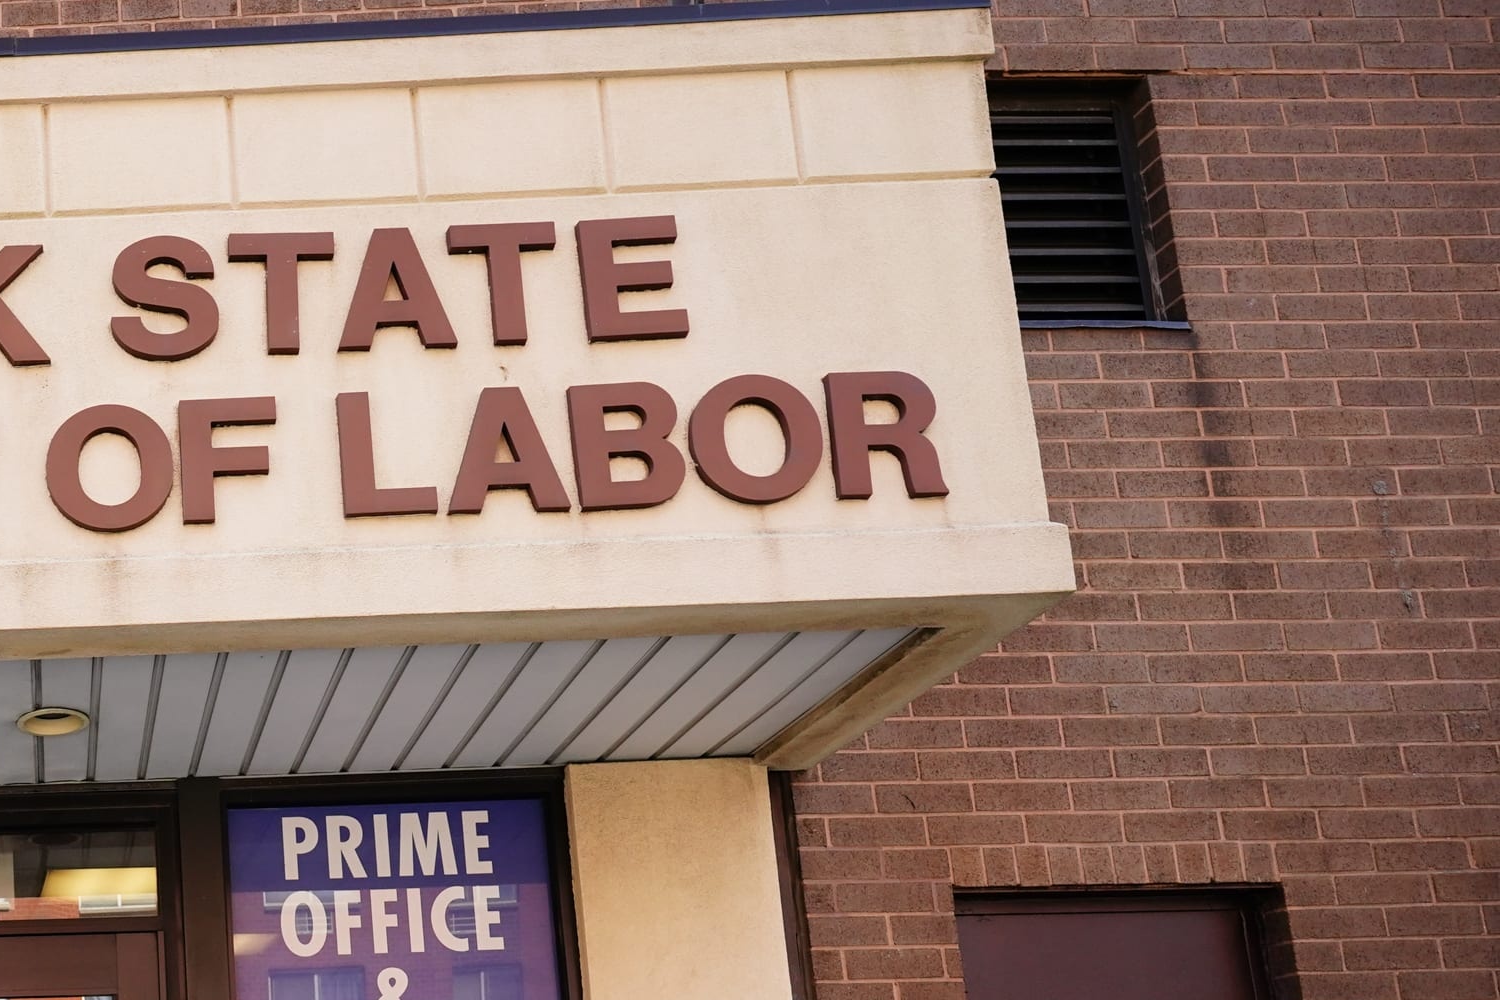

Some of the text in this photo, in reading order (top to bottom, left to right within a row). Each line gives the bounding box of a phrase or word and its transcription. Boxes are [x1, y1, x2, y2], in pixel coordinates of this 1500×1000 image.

[110, 214, 690, 362] STATE
[44, 395, 278, 534] OF
[335, 370, 950, 520] LABOR
[281, 810, 494, 881] PRIME
[280, 885, 505, 957] OFFICE
